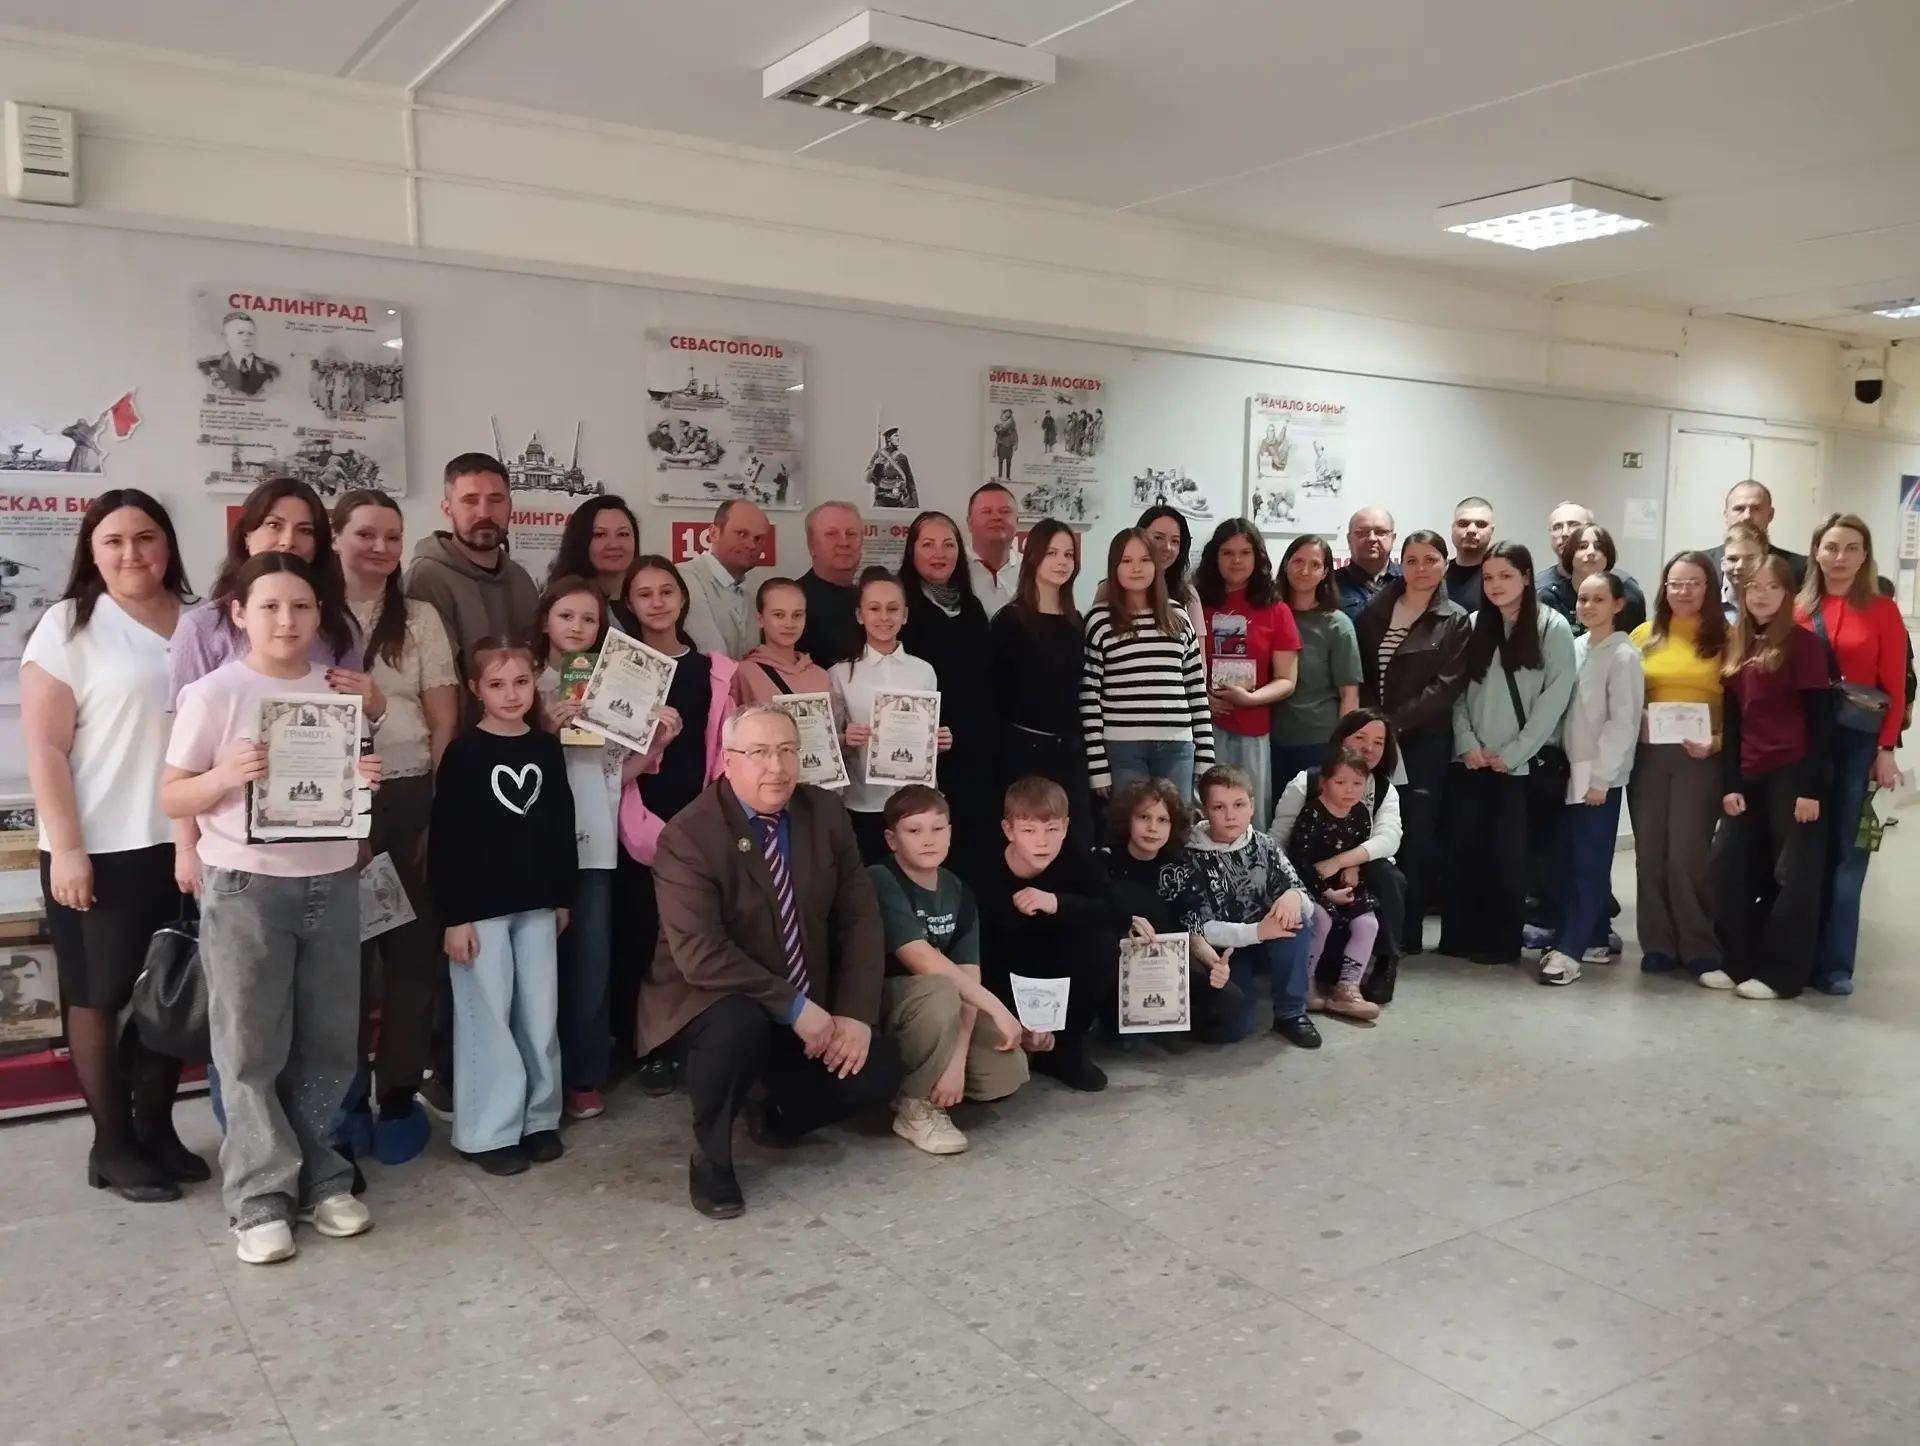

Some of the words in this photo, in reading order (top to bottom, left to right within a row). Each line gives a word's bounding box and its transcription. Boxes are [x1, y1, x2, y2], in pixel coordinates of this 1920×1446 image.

[228, 293, 368, 324] СТАЛИНГРАД
[670, 335, 784, 359] СЕВАСТОПОЛЬ
[990, 370, 1028, 385] БИТВА
[1032, 374, 1048, 387] ЗА
[1260, 397, 1304, 411] НАЧАЛО
